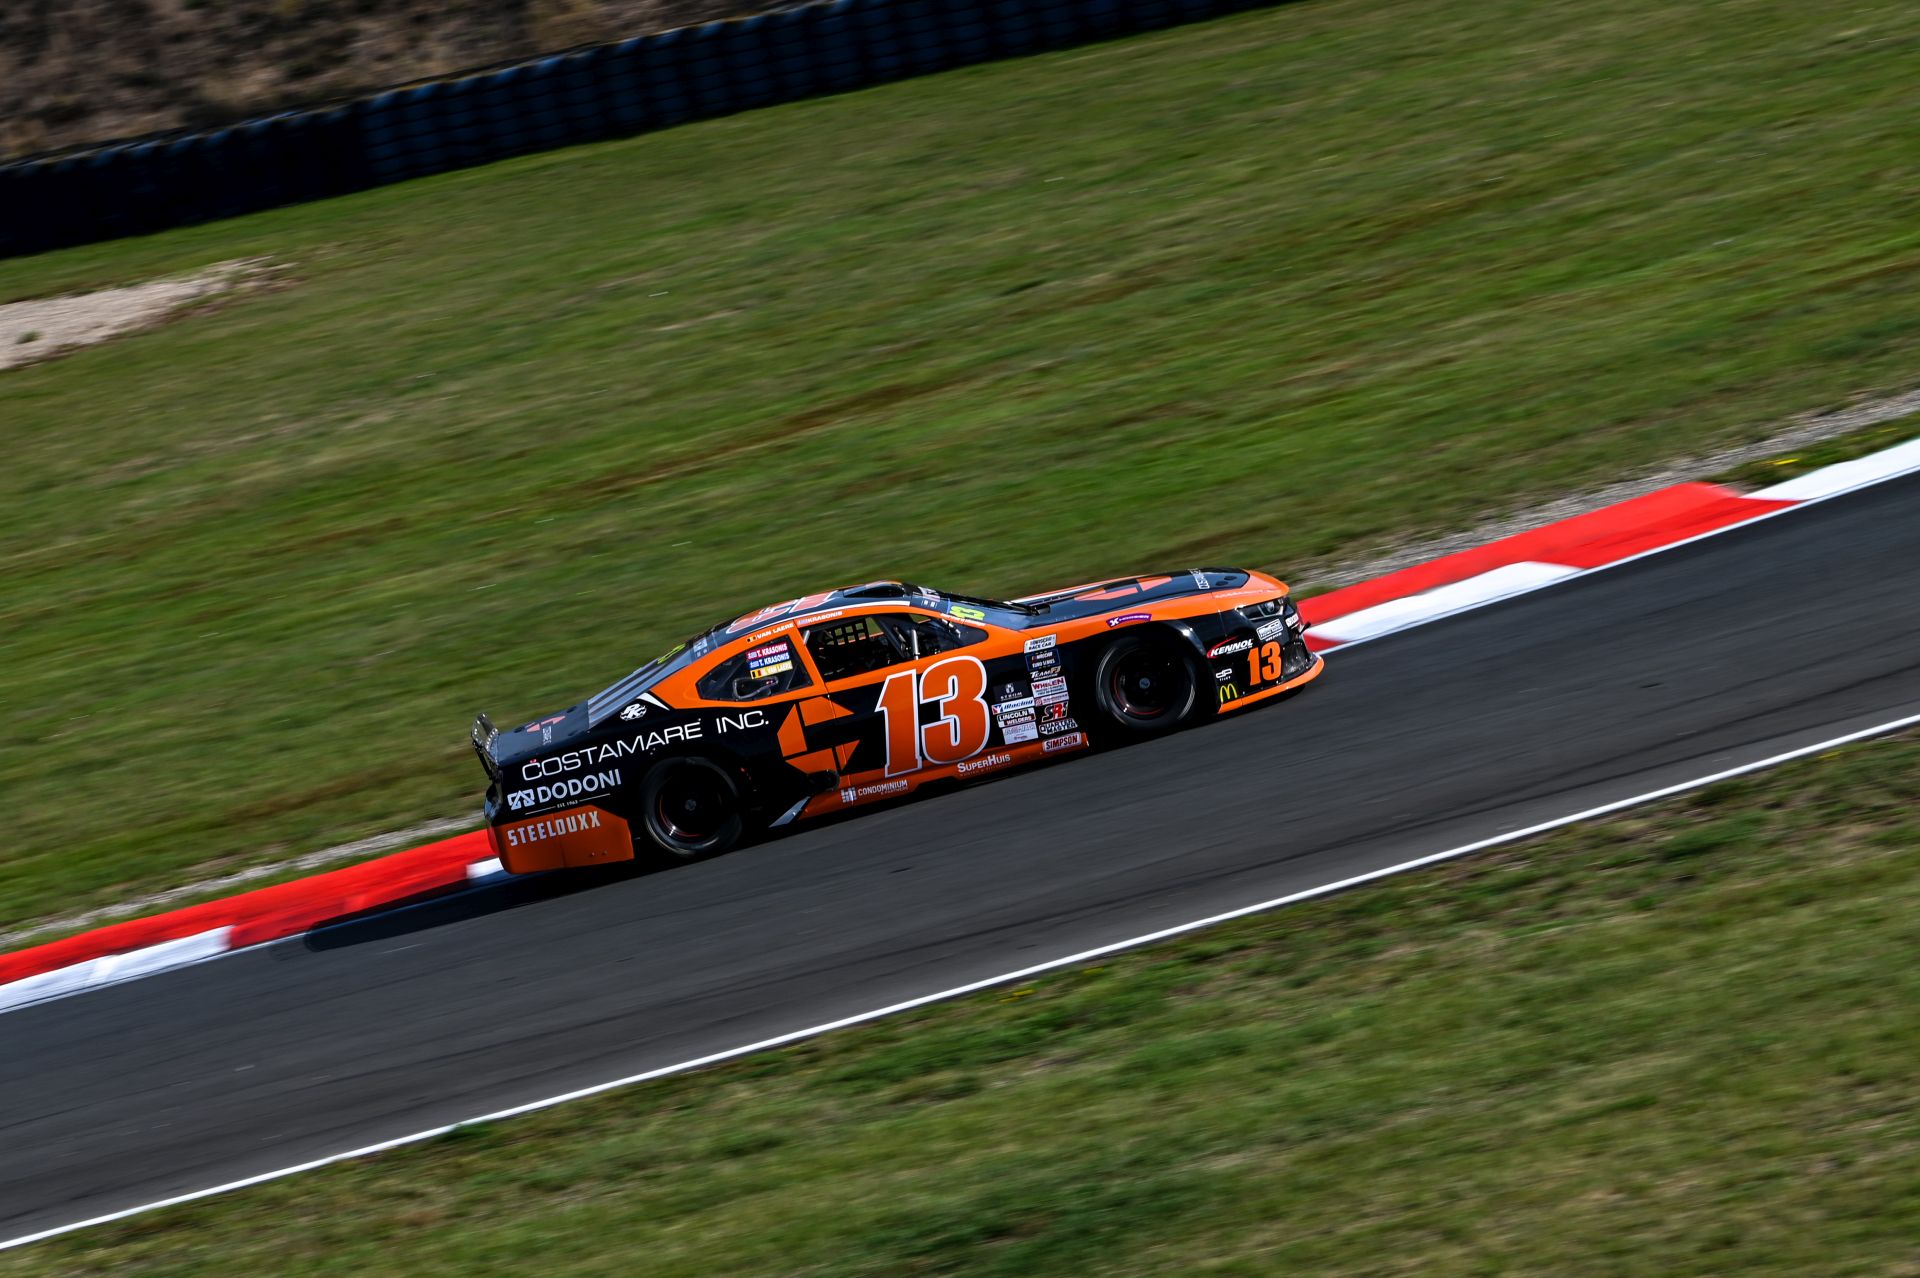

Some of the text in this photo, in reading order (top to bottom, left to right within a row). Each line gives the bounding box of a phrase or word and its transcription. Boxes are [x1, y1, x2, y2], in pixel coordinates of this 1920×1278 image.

[807, 611, 843, 624] KRASONIS
[762, 643, 788, 656] KRASONIS
[1211, 638, 1254, 656] KENNOL
[764, 653, 790, 665] KRASONIS
[1247, 641, 1282, 686] 13
[1032, 677, 1064, 690] WHELEN
[874, 655, 989, 779] 13
[999, 709, 1028, 720] LINCOLN
[522, 722, 703, 781] COSTAMARE
[716, 710, 770, 735] INC.
[1046, 734, 1078, 750] SIMPSON
[537, 769, 622, 803] DODONI
[858, 779, 908, 797] CONDOMINIUM
[507, 811, 601, 847] STEELDUXX
